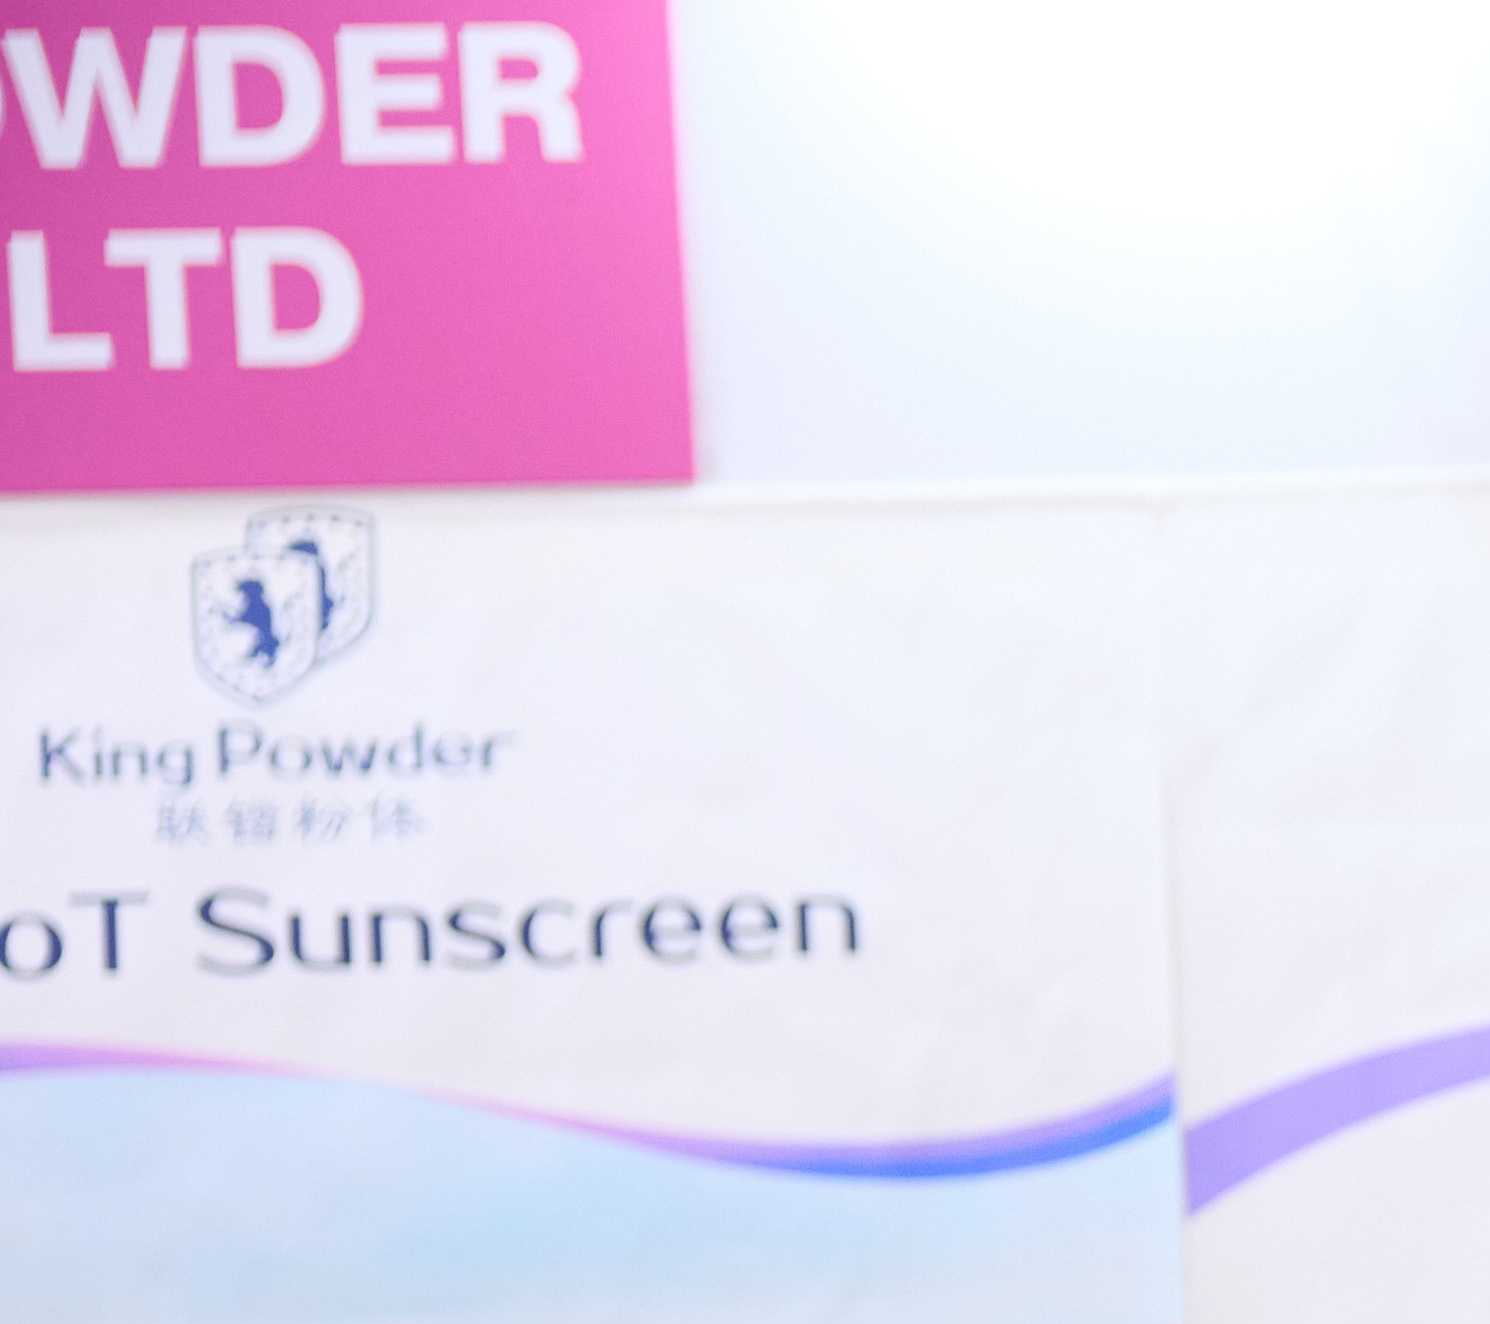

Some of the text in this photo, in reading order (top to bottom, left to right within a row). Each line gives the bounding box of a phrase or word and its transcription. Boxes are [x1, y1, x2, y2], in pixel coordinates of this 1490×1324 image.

[0, 22, 583, 170] WDER
[5, 226, 364, 372] LTD
[37, 716, 516, 788] King Powder
[195, 886, 864, 980] Sunscreen
